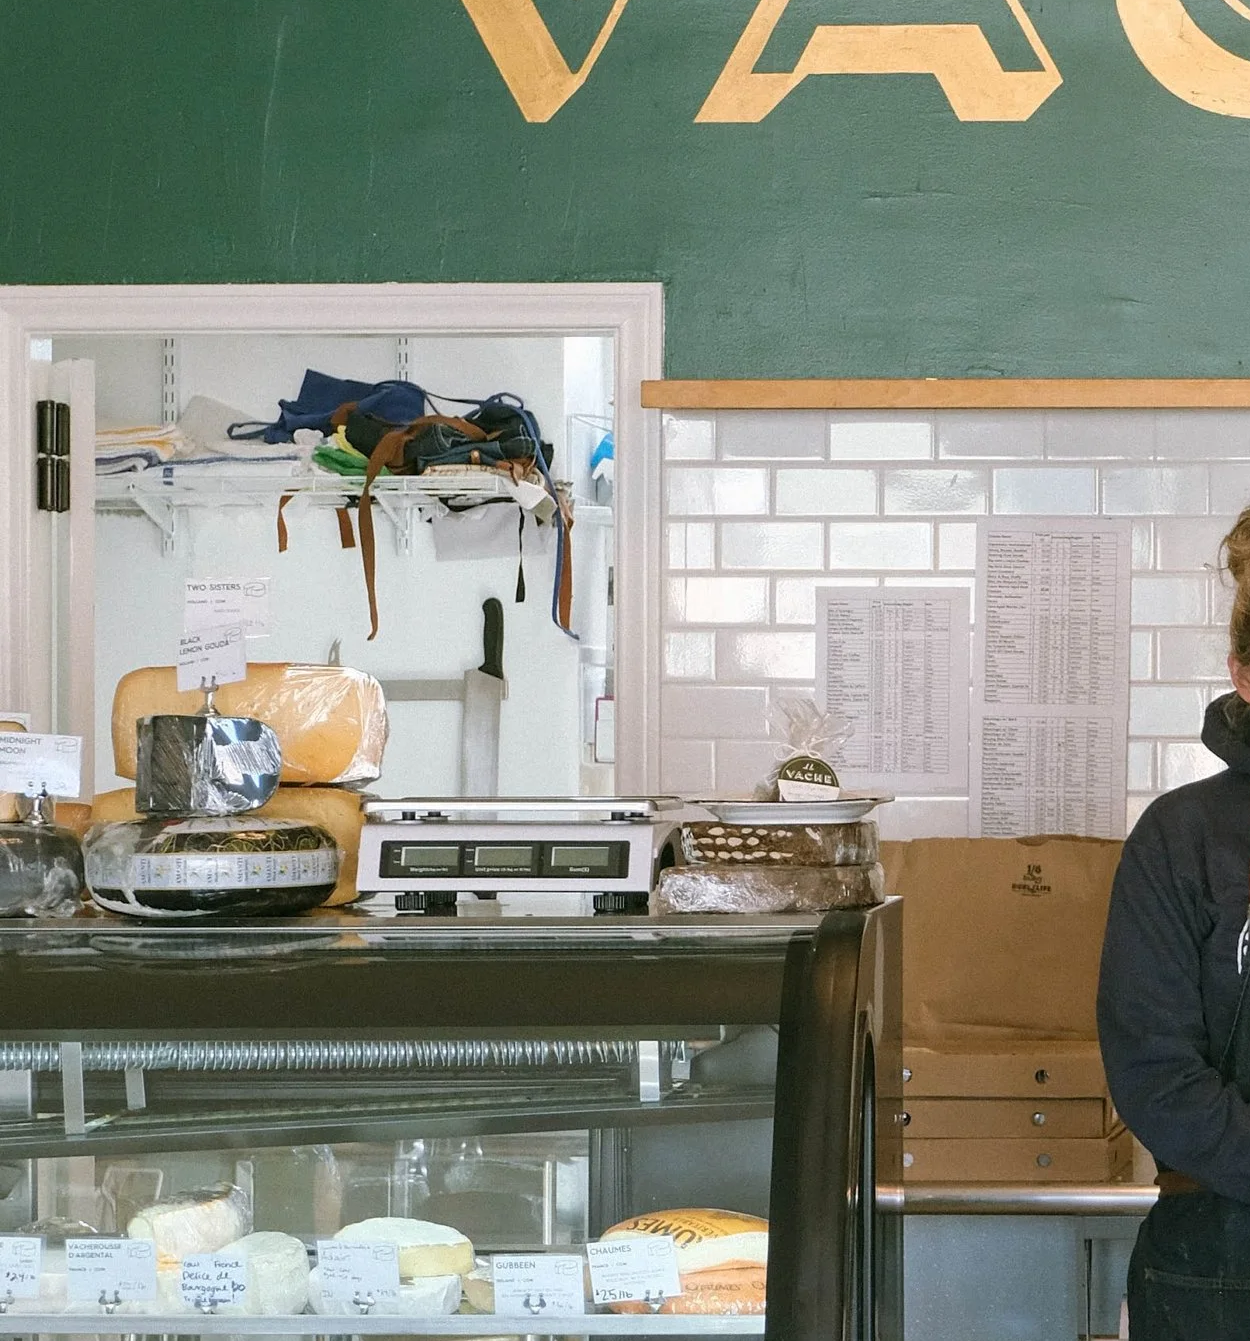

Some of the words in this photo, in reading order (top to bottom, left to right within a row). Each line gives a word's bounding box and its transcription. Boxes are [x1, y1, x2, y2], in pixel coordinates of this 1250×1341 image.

[786, 770, 832, 784] VACHE
[590, 1244, 632, 1256] CHAUMES
[496, 1261, 536, 1270] GUBBEEN
